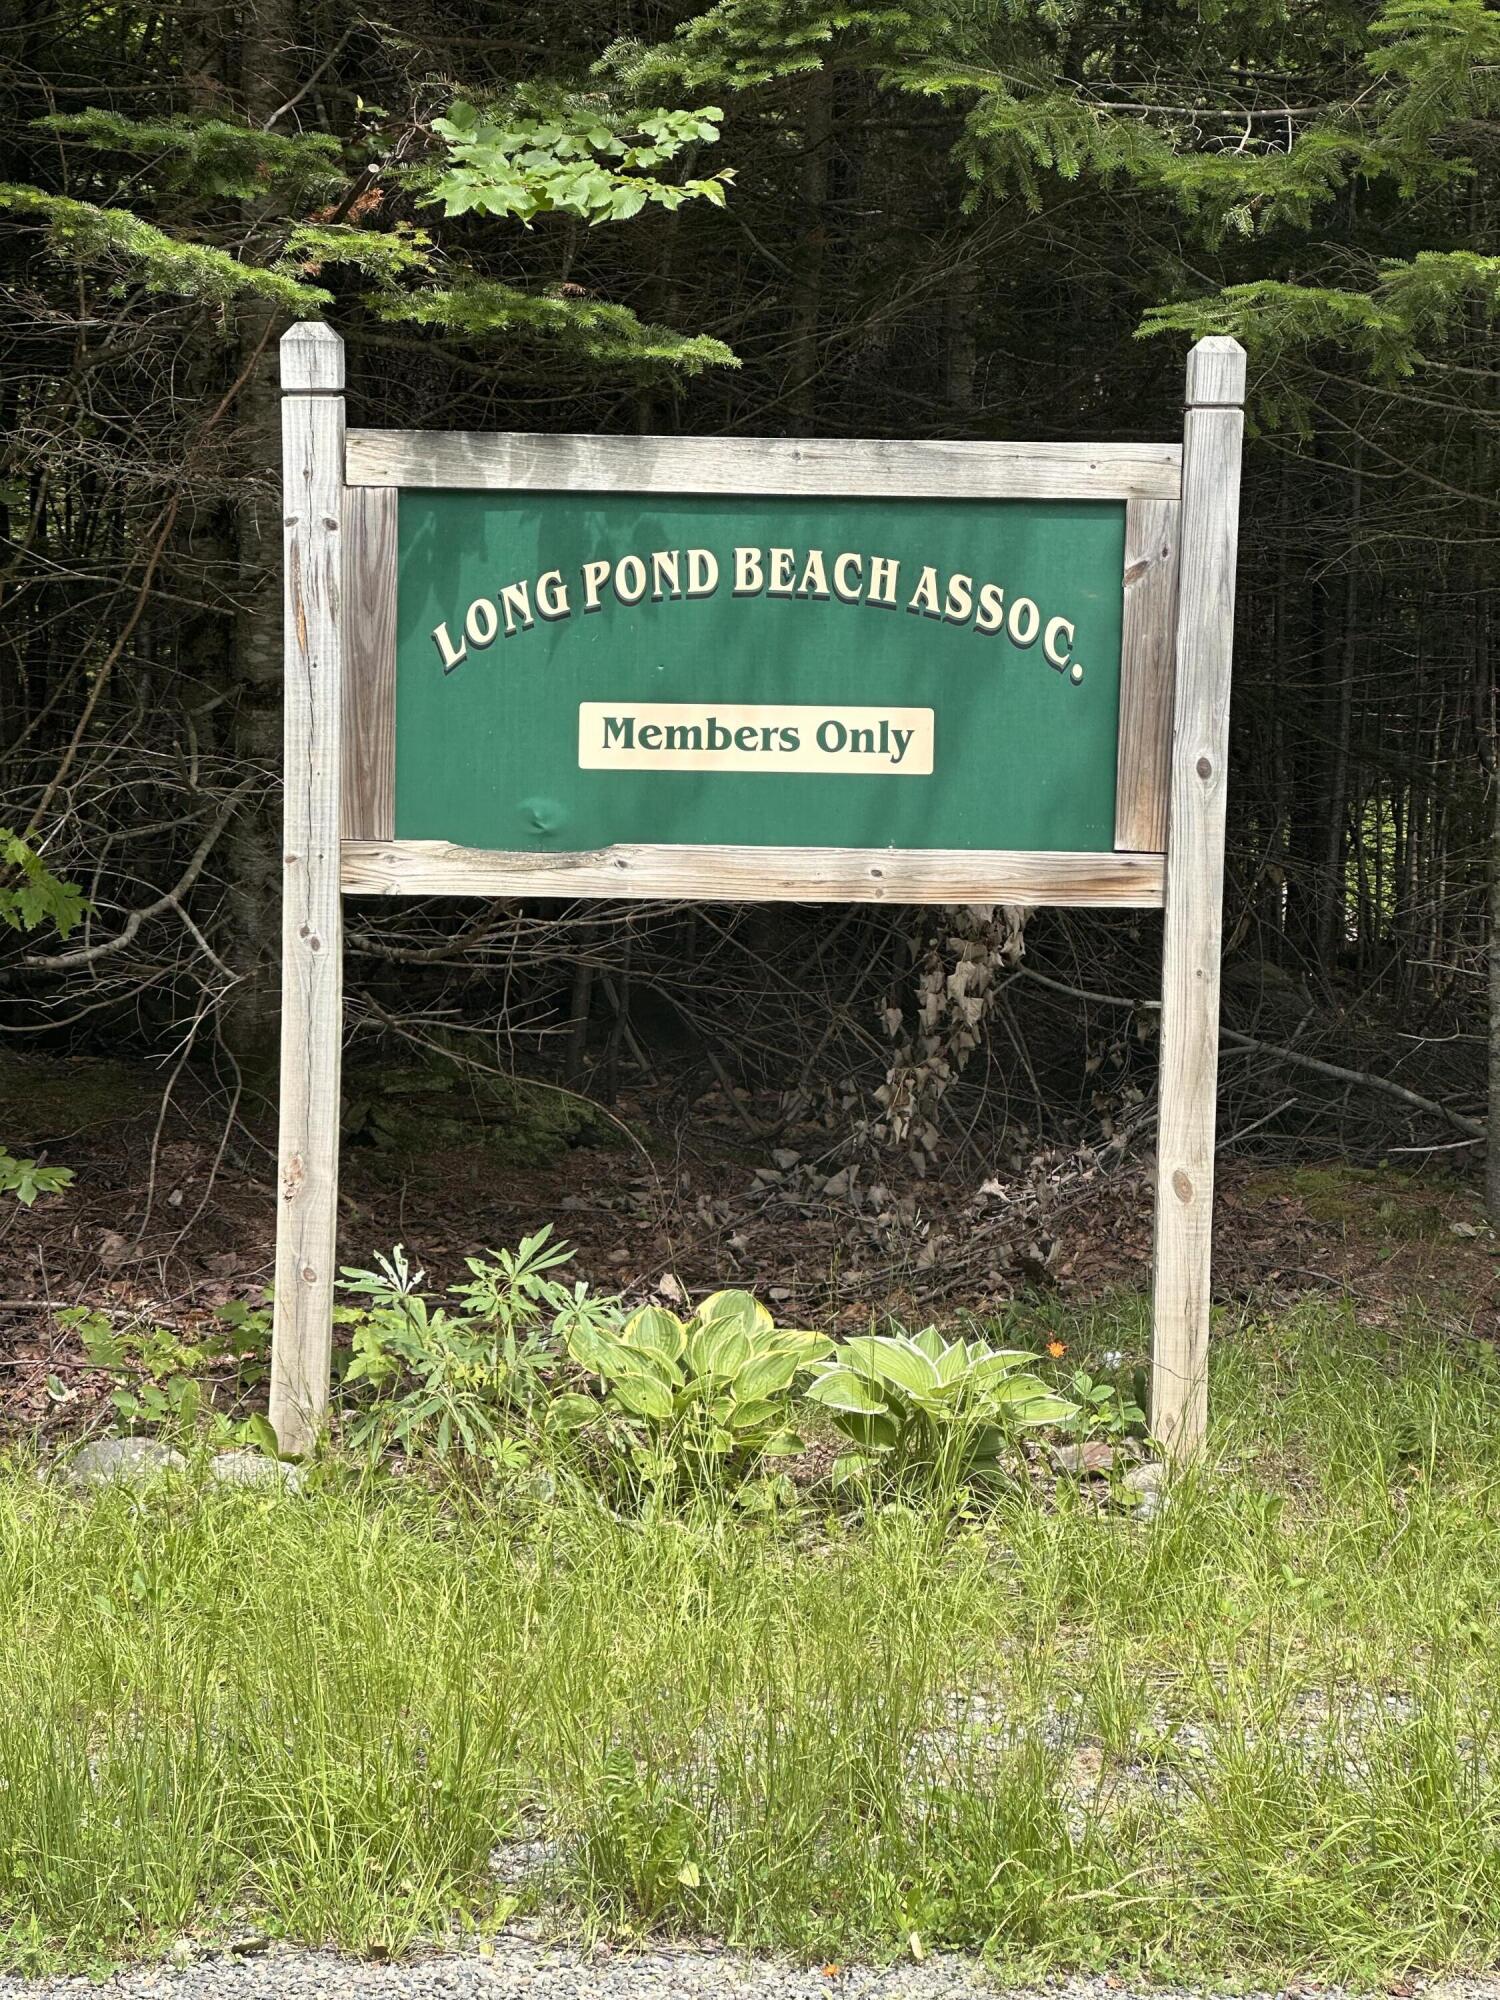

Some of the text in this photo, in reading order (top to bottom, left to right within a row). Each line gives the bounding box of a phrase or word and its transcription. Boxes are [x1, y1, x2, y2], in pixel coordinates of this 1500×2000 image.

[432, 547, 1083, 680] LONG POND BEACH ASSOC.
[603, 717, 915, 764] Members Only
